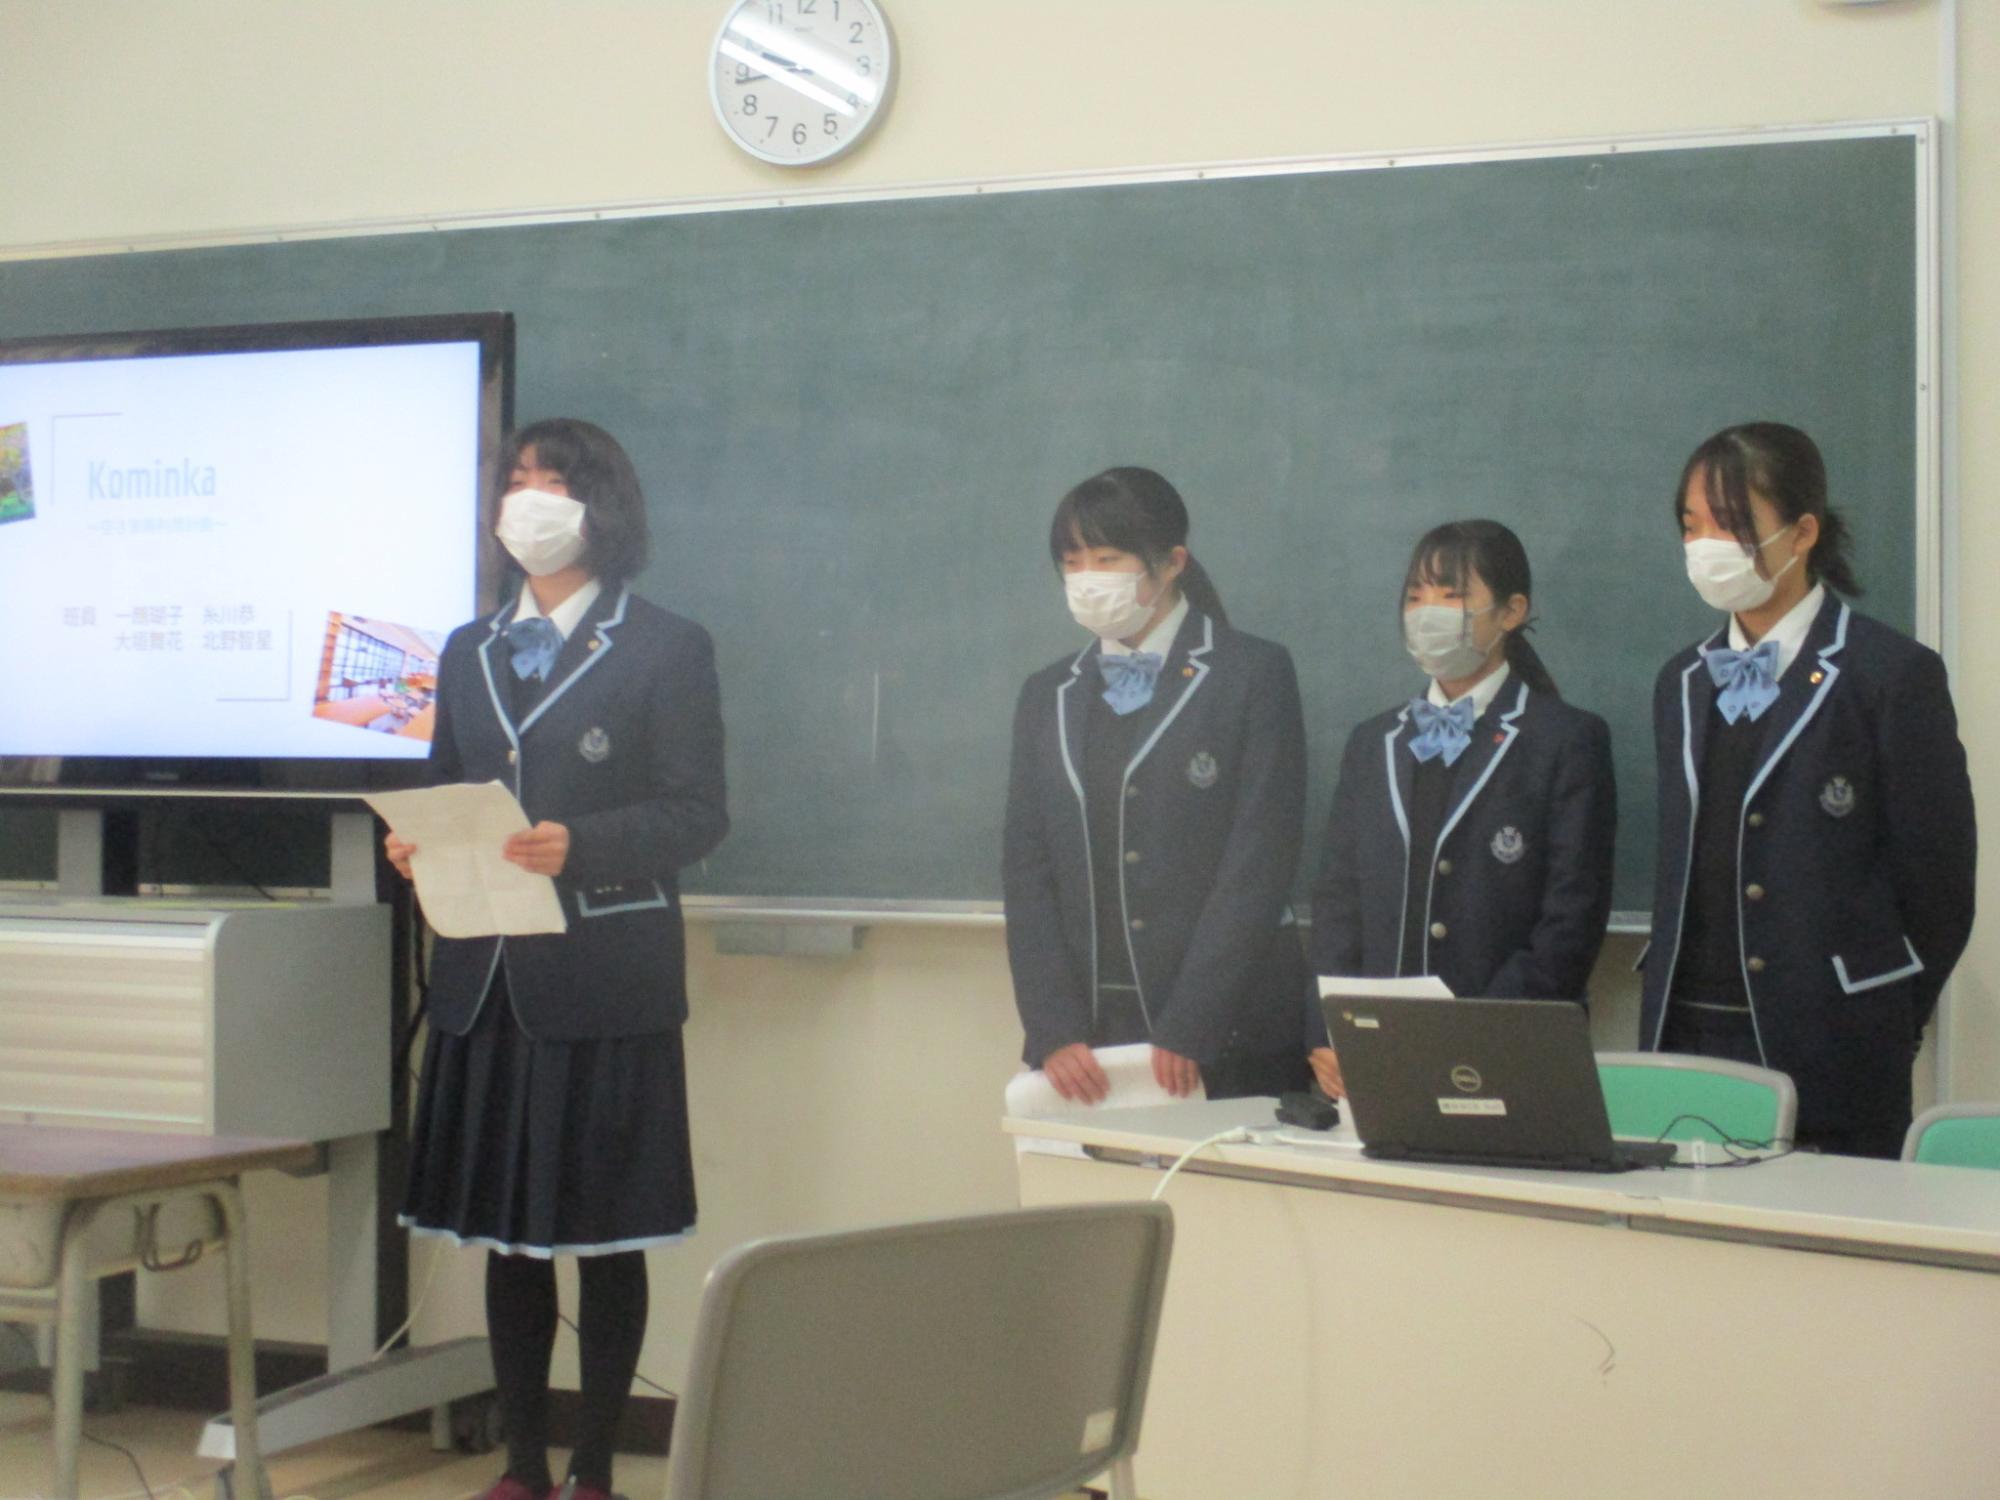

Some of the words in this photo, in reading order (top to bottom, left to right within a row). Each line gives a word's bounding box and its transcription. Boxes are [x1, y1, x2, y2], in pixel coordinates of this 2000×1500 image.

[832, 0, 840, 22] 1
[849, 22, 864, 44] 2
[856, 55, 871, 77] 3
[742, 94, 758, 116] 8
[765, 116, 779, 138] 7
[792, 123, 807, 145] 6
[823, 113, 838, 135] 5
[88, 457, 216, 500] Kominka
